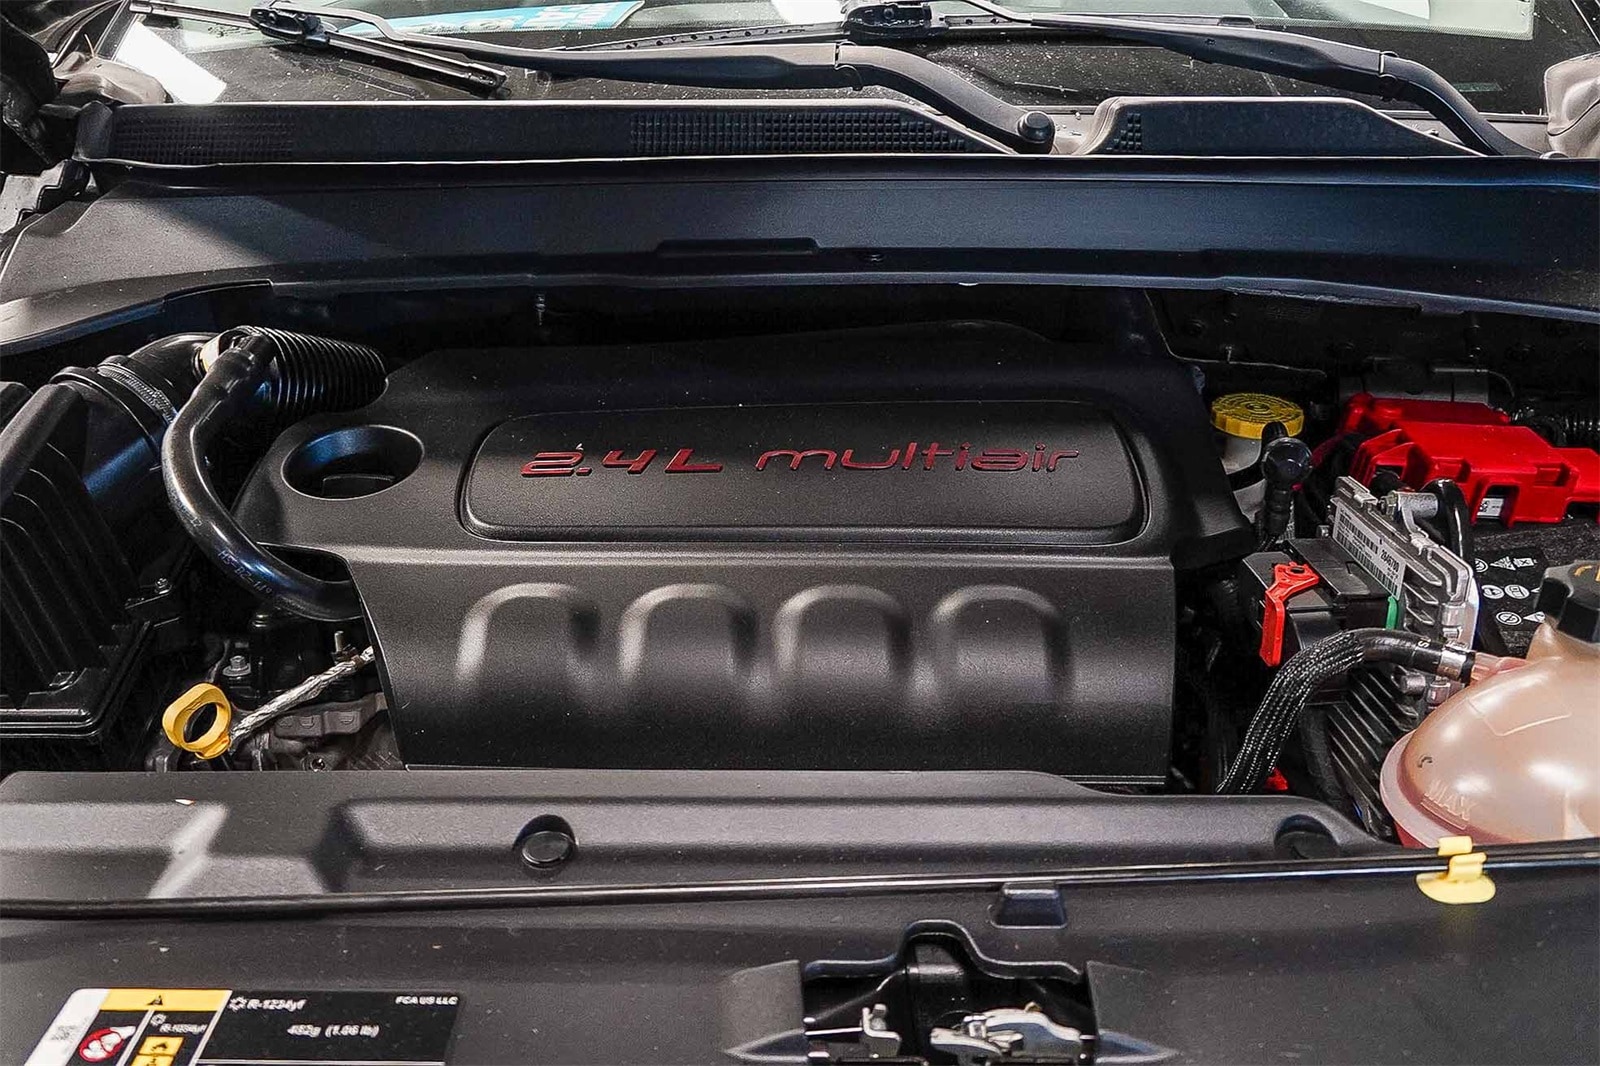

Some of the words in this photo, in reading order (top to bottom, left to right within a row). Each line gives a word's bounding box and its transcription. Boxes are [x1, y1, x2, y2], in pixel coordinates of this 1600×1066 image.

[755, 442, 1079, 471] multiair
[395, 996, 418, 1005] FCA
[419, 996, 435, 1005] US
[435, 996, 458, 1005] LLC
